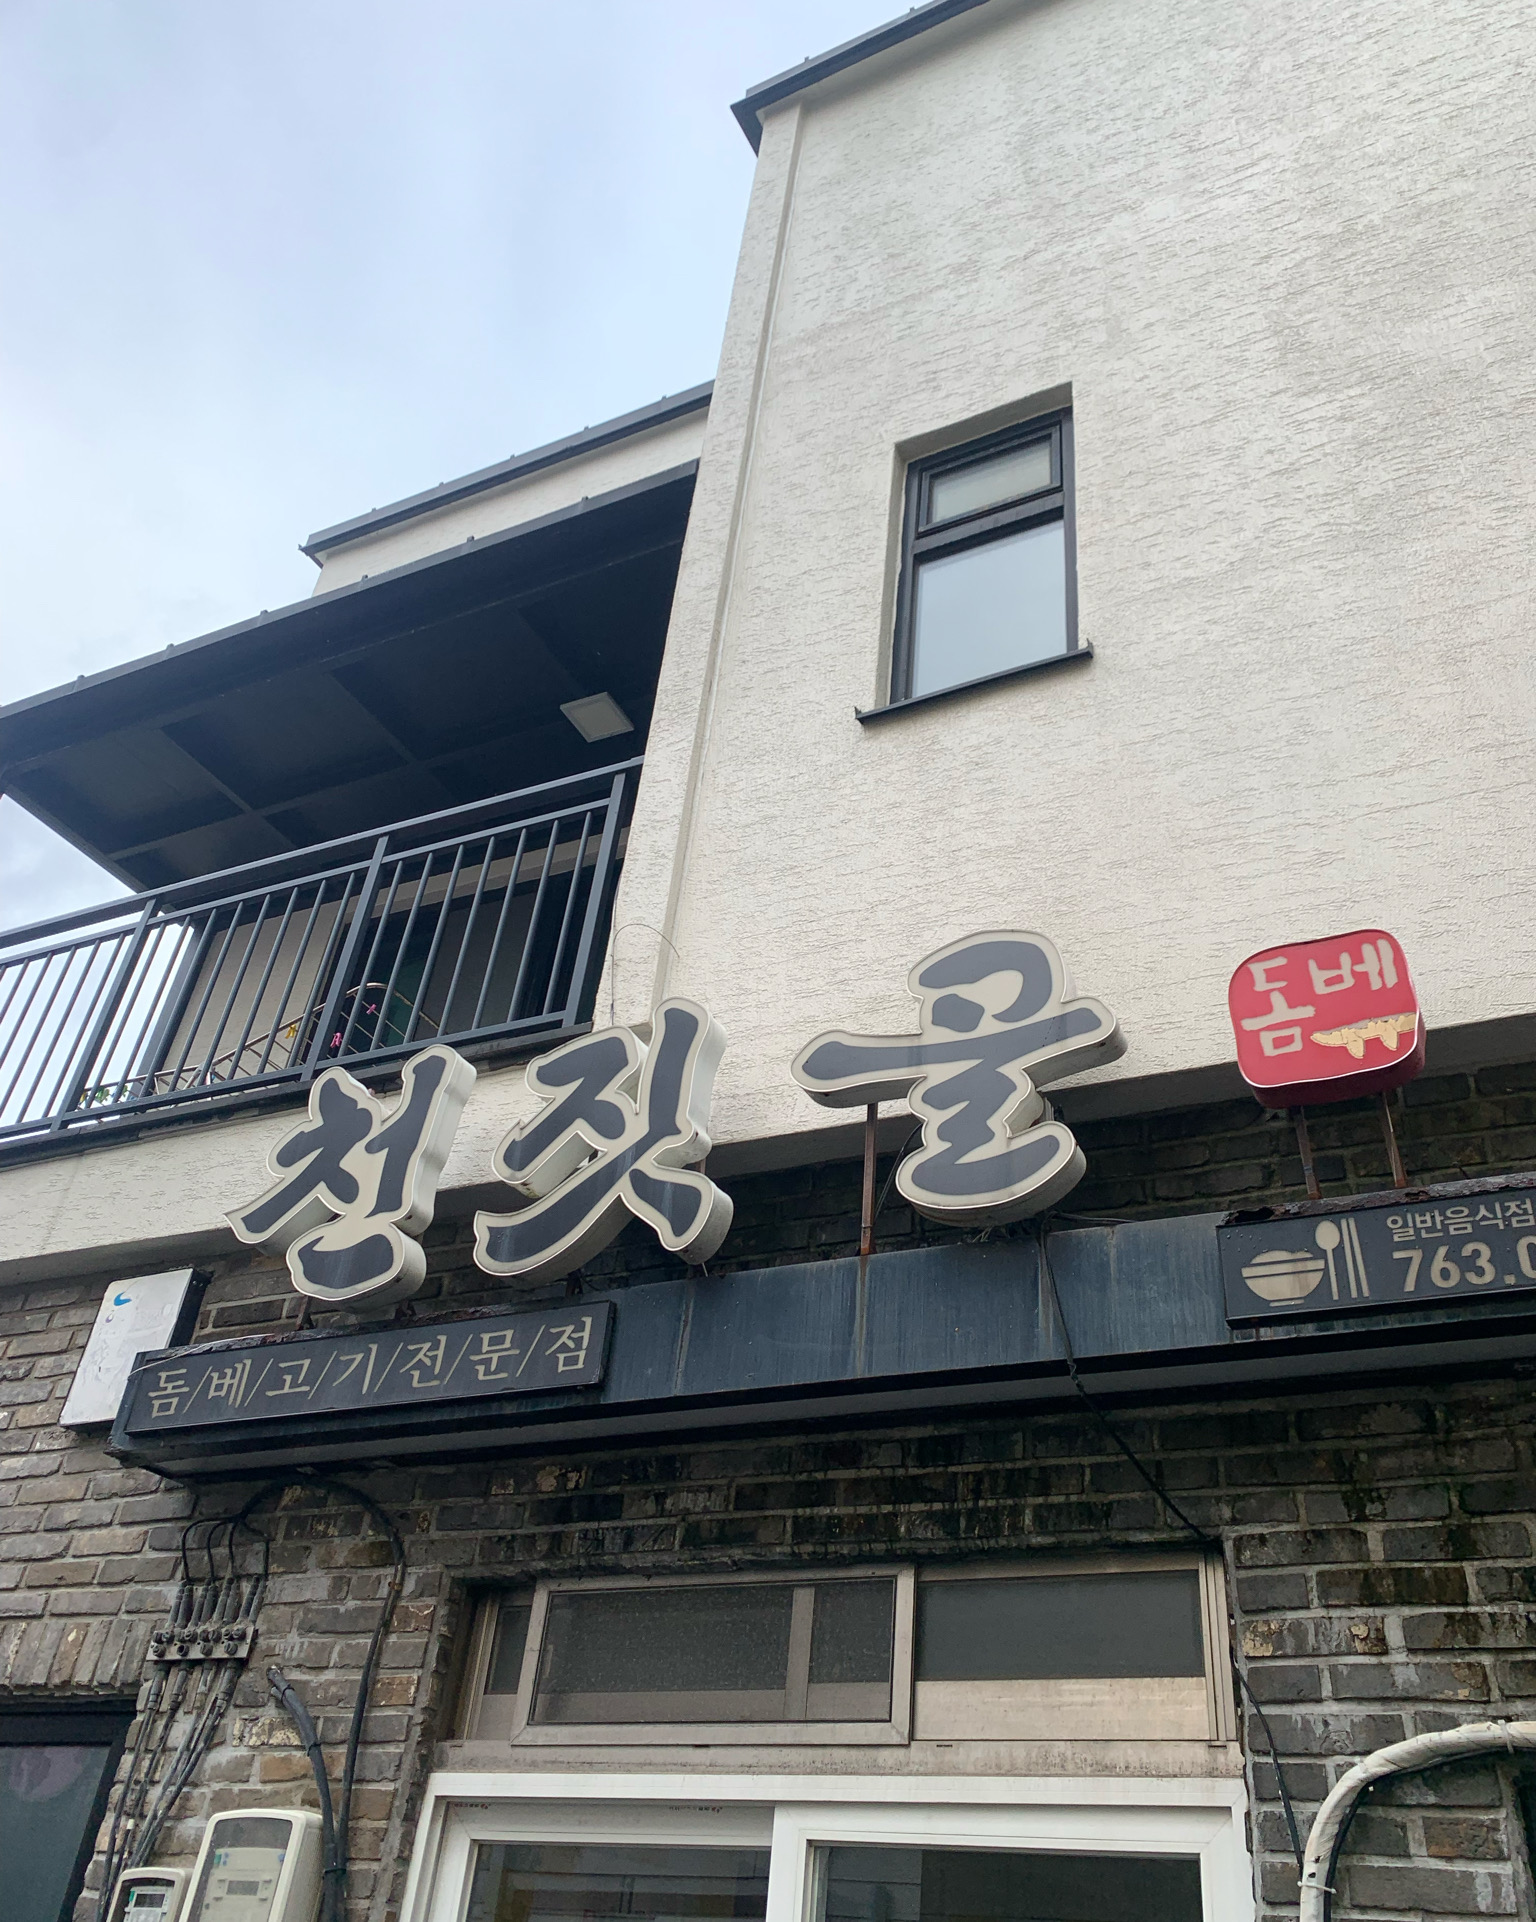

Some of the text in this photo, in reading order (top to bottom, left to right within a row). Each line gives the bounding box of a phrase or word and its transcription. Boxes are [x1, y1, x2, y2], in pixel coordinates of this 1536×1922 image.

[1241, 938, 1398, 1057] 돔베
[230, 934, 1118, 1296] 천짓골
[1386, 1198, 1536, 1243] 일반음식점
